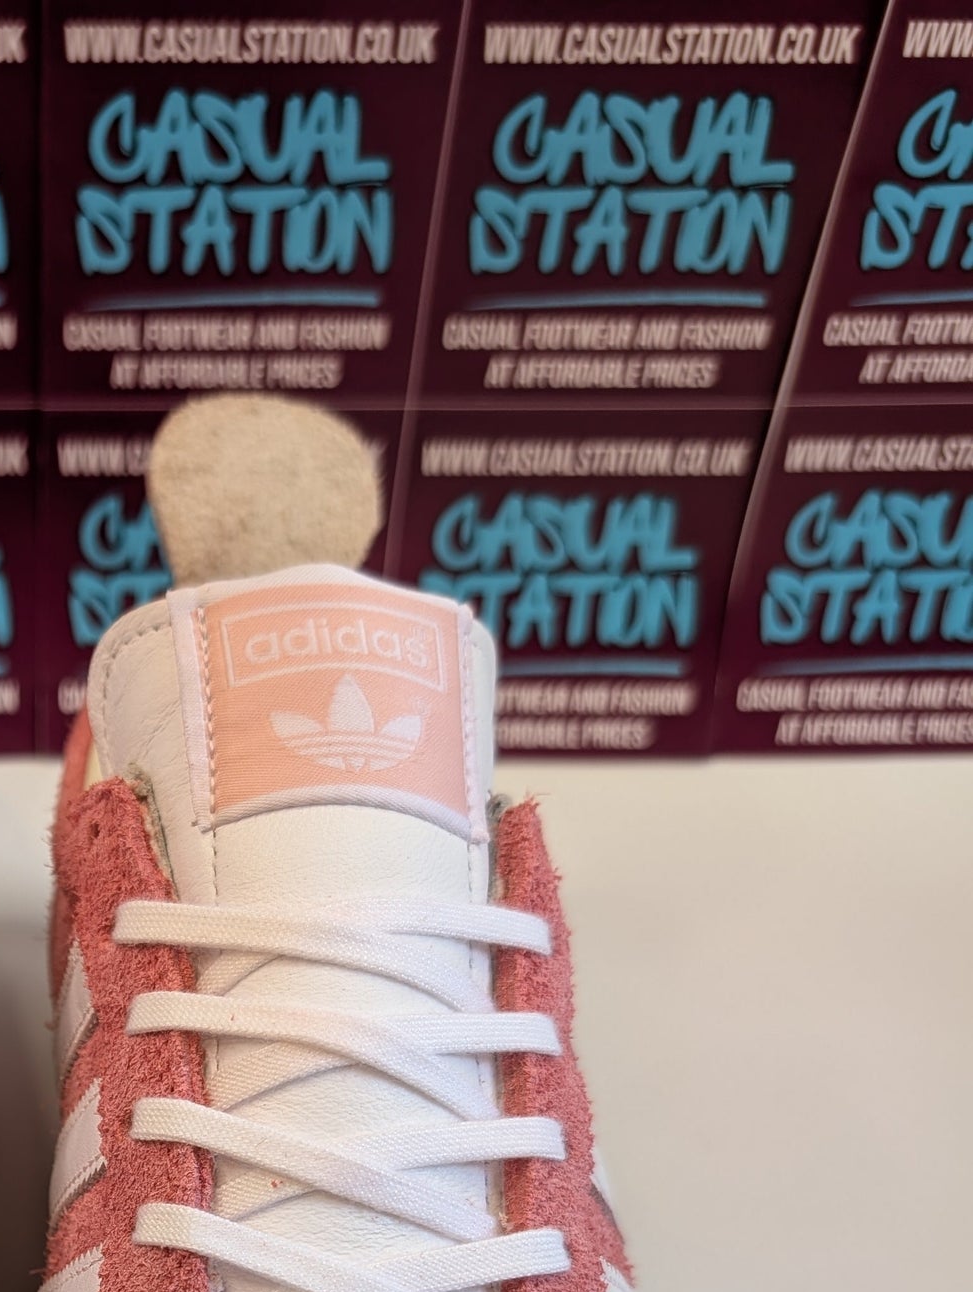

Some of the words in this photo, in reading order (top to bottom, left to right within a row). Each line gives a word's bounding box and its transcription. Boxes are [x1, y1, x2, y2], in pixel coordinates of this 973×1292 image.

[64, 21, 438, 65] WWW.CASUALSTATION.CO.UK
[483, 22, 861, 65] WWW.CASUALSTATION.CO.UK
[89, 90, 390, 186] CASUAL
[493, 91, 795, 186] CASUAL
[77, 187, 394, 277] STATION
[470, 186, 792, 276] STATION
[442, 314, 524, 350] CASUAL
[523, 312, 636, 350] FOOTWEAR
[633, 312, 681, 350] AND
[680, 311, 773, 350] FASHION
[823, 312, 904, 346] CASUAL
[484, 354, 517, 389] AT
[513, 353, 643, 389] AFFORDABLE
[641, 353, 723, 389] PRICES
[859, 351, 894, 384] AT
[432, 493, 697, 574] CASUAL
[246, 618, 428, 667] adidas
